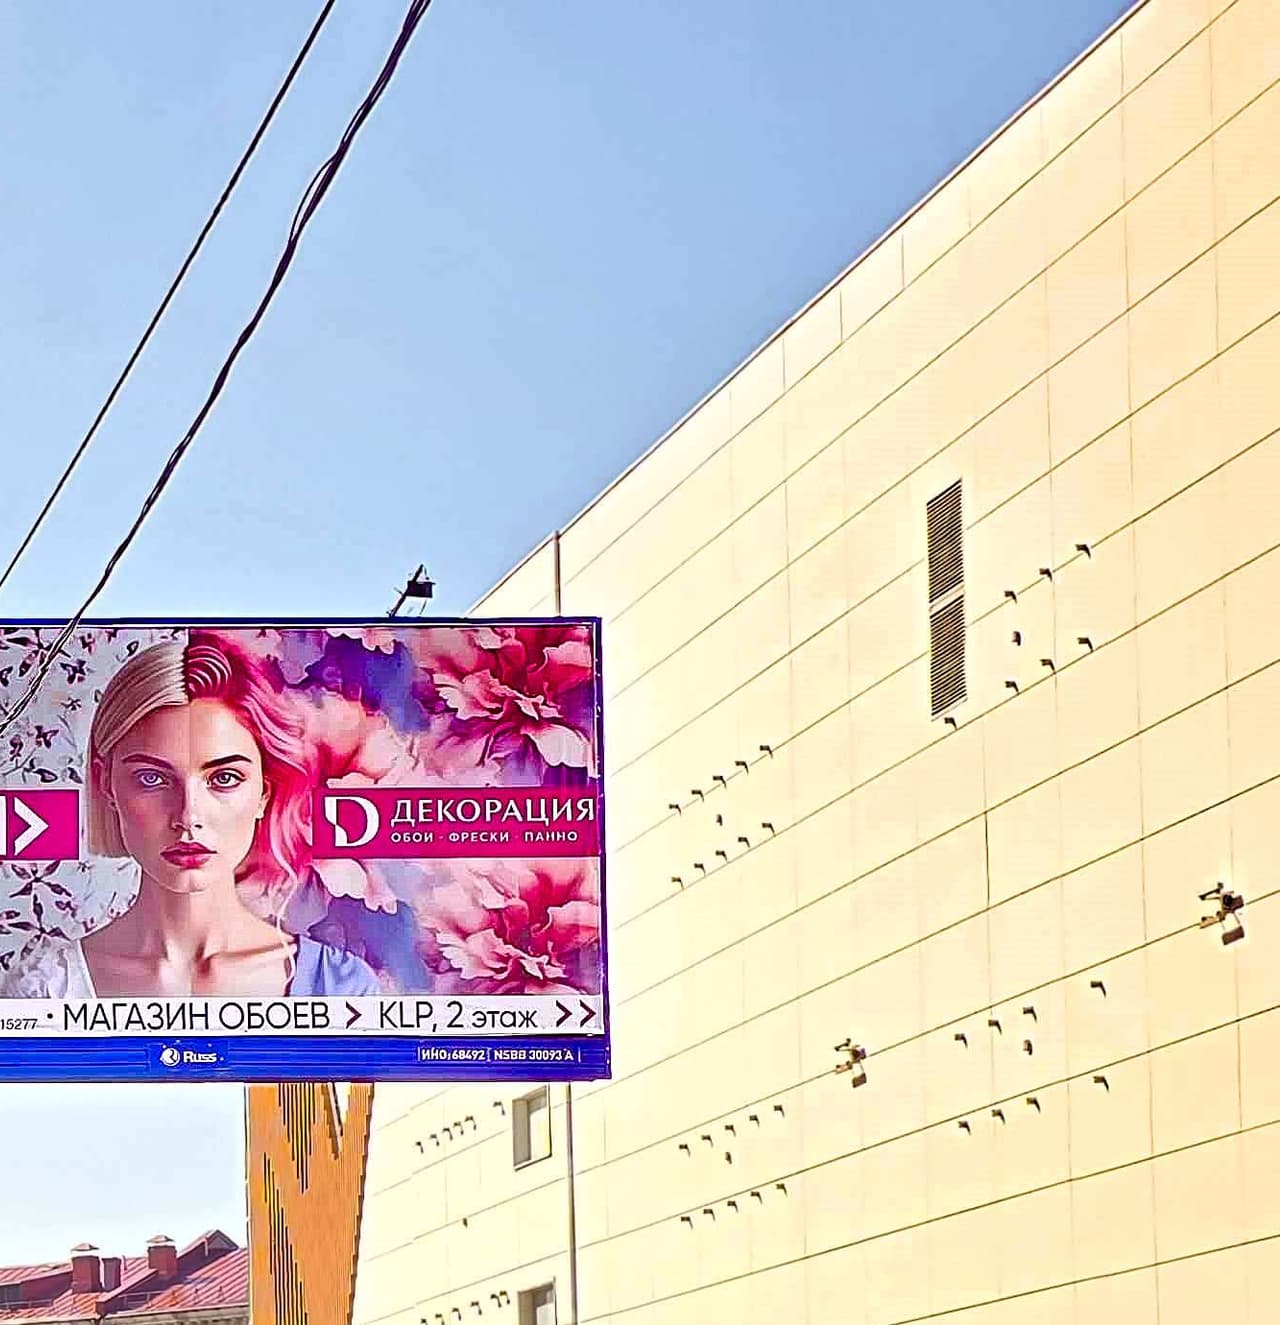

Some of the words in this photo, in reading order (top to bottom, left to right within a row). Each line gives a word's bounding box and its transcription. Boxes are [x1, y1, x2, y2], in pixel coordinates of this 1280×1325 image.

[390, 797, 595, 827] ДЕКОРАЦИЯ
[390, 831, 434, 844] ОБОИ
[448, 831, 510, 844] ФРЕСКИ
[524, 830, 578, 843] ПАННО
[63, 1002, 209, 1031] МАГАЗИН
[219, 1001, 330, 1030] ОБОЕВ
[379, 1000, 438, 1033] KLP,
[446, 1000, 464, 1028] 2
[471, 1009, 538, 1028] этаж
